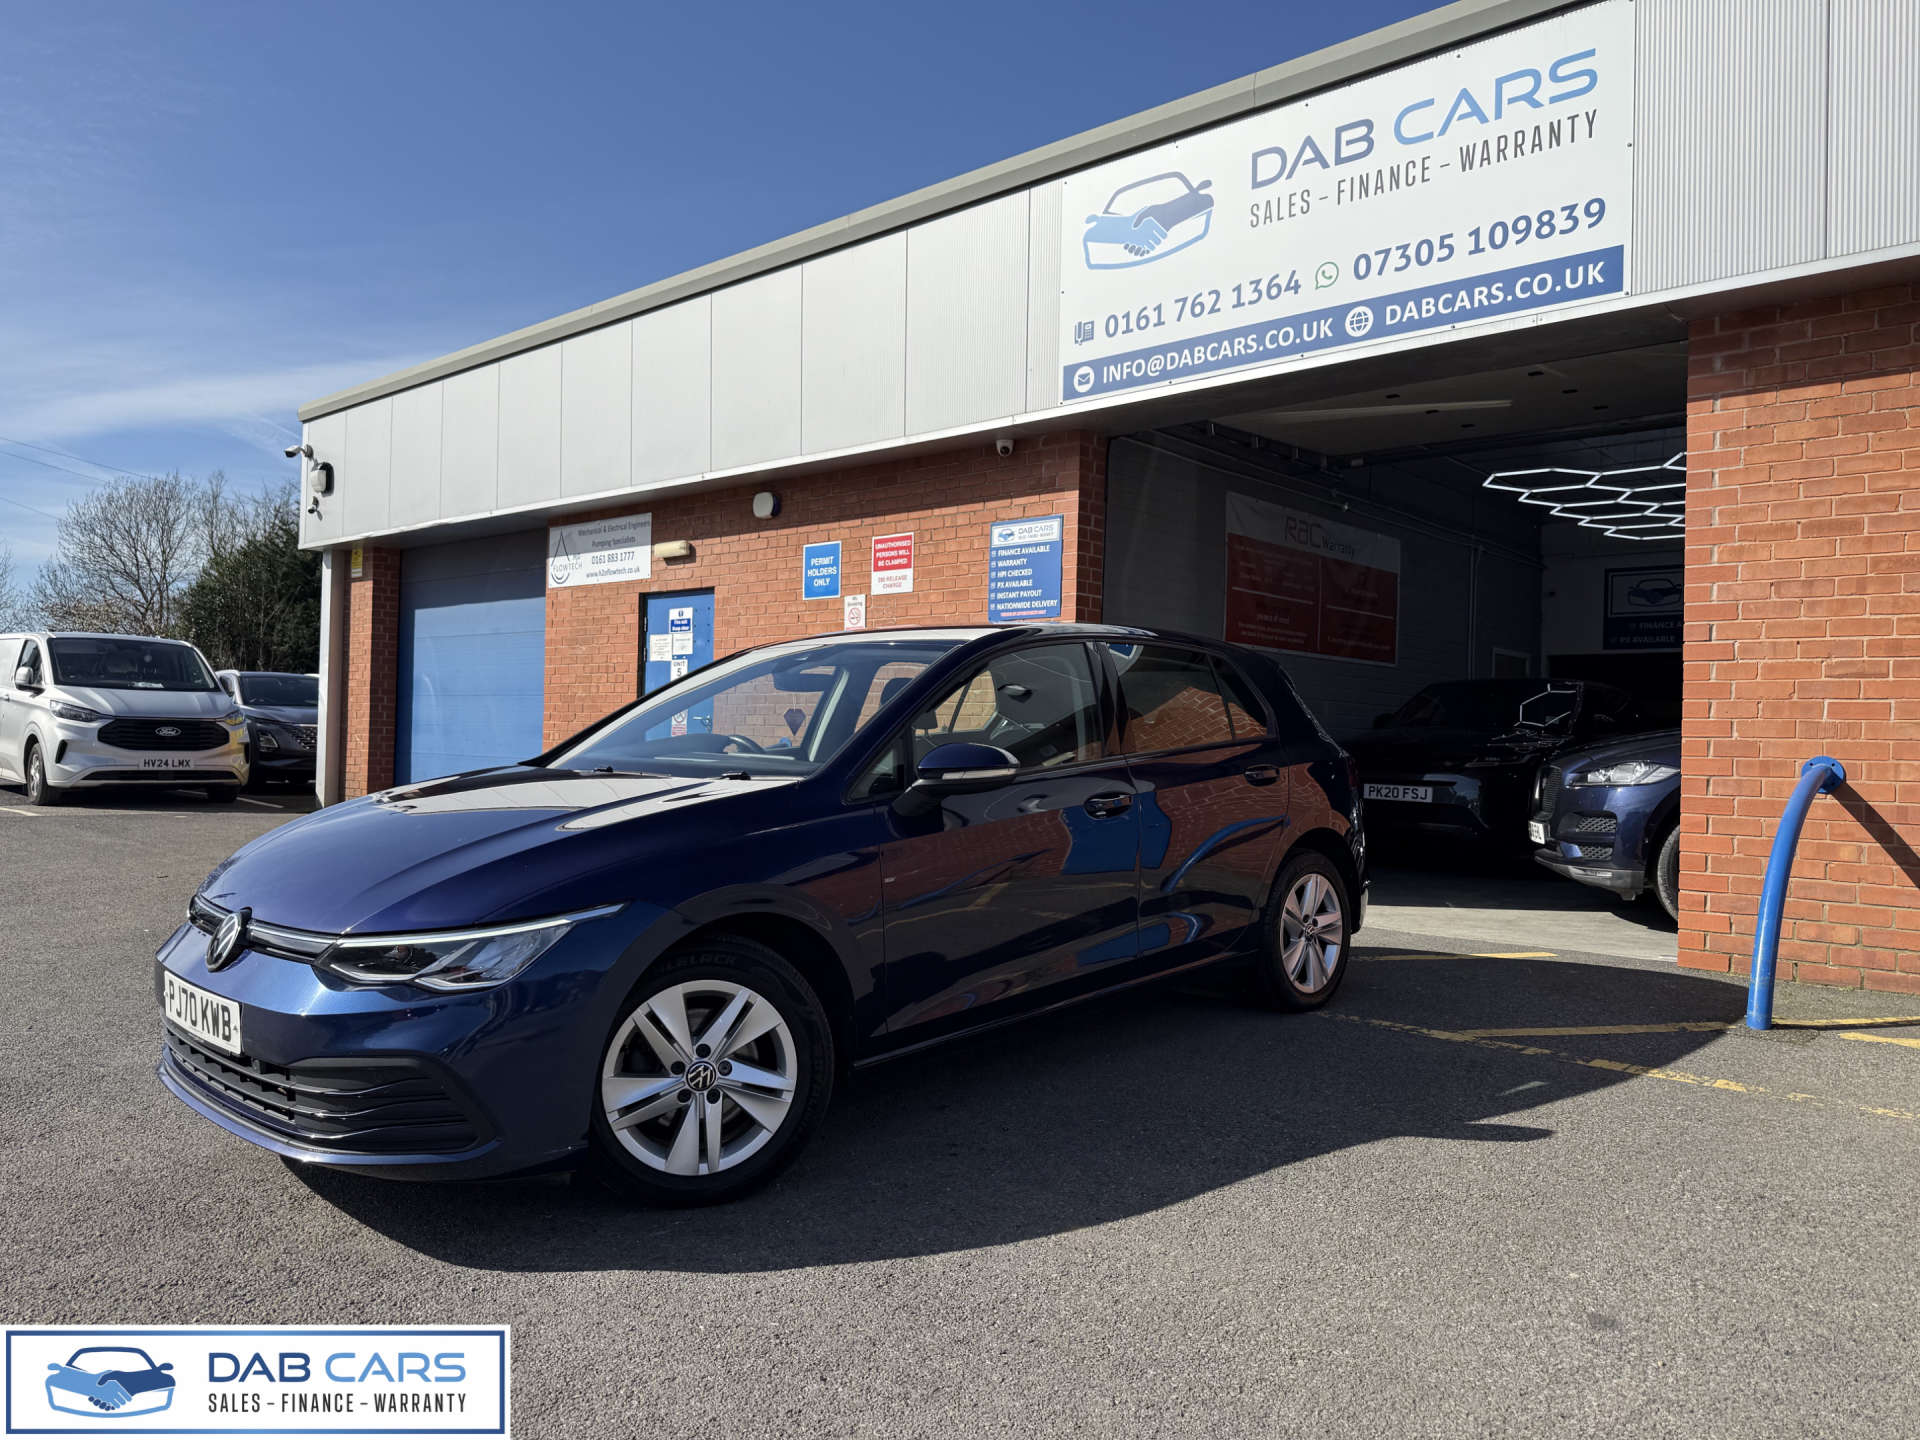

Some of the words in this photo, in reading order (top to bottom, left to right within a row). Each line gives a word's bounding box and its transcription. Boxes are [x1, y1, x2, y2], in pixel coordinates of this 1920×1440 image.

[1251, 118, 1375, 190] DAB
[1393, 47, 1598, 145] CARS
[1250, 189, 1311, 228] SALES
[1337, 155, 1431, 205] FINANCE
[1459, 108, 1597, 172] WARRANTY
[1353, 232, 1455, 280] 07305
[1467, 197, 1606, 256] 109839
[1385, 261, 1605, 326] DABCARS.CO.UK
[1104, 303, 1166, 338] 0161
[1174, 289, 1222, 322] 762
[1231, 270, 1301, 309] 1364
[1102, 318, 1334, 384] INFO@DABCARS.CO.UK
[1018, 527, 1033, 535] DAB
[1034, 524, 1054, 533] CARS
[998, 547, 1021, 557] FINANCE
[1021, 544, 1050, 554] AVAILABLE
[810, 556, 834, 566] PERMIT
[877, 559, 885, 567] BE
[998, 558, 1027, 567] WARRANTY
[807, 566, 837, 577] HOLDERS
[1007, 568, 1032, 577] CHECKED
[813, 578, 831, 587] ONLY
[1005, 579, 1033, 588] AVAILABLE
[997, 591, 1019, 599] INSTANT
[1020, 589, 1042, 598] PAYOUT
[997, 601, 1031, 610] NATIONWIDE
[1031, 600, 1058, 608] DELIVERY
[677, 668, 682, 677] 5
[143, 759, 169, 768] HV24
[1368, 785, 1399, 798] PK20
[1402, 787, 1428, 801] FSJ
[168, 979, 197, 1027] PJ70
[201, 996, 231, 1042] KWB
